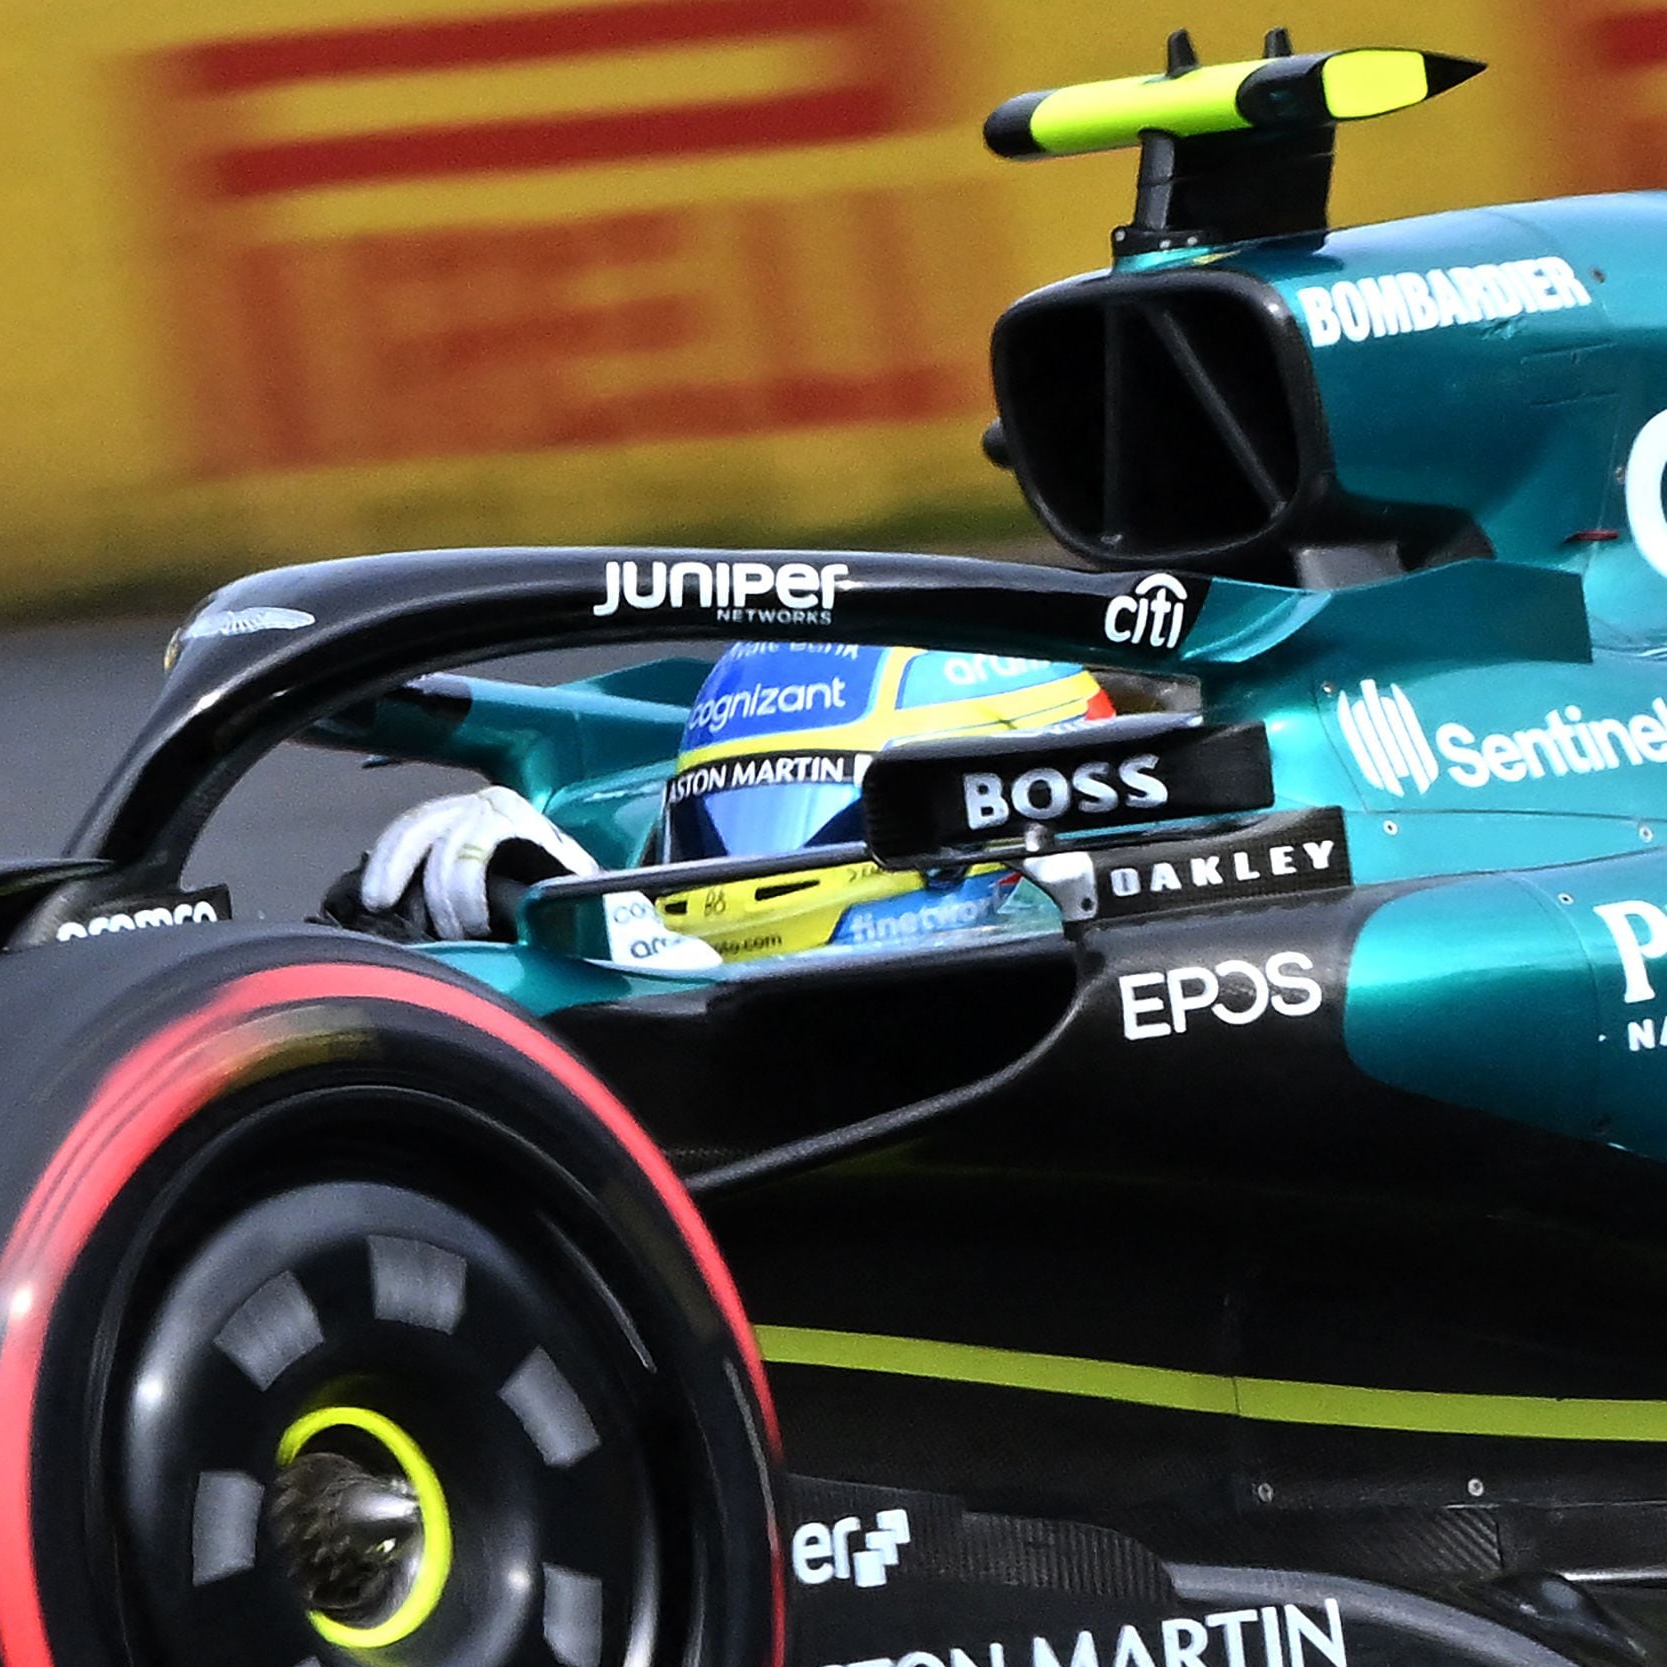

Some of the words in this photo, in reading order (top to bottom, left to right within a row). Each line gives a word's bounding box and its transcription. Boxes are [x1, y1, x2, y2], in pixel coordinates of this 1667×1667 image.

[1297, 256, 1593, 348] BOMBARDIER
[717, 608, 832, 626] NETWORKS
[1105, 573, 1188, 648] citi
[688, 676, 847, 733] cognizant
[669, 764, 727, 804] ASTON
[731, 756, 845, 787] MARTIN
[963, 753, 1168, 831] BOSS
[1110, 840, 1335, 897] OAKLEY
[1118, 951, 1323, 1041] EPOS
